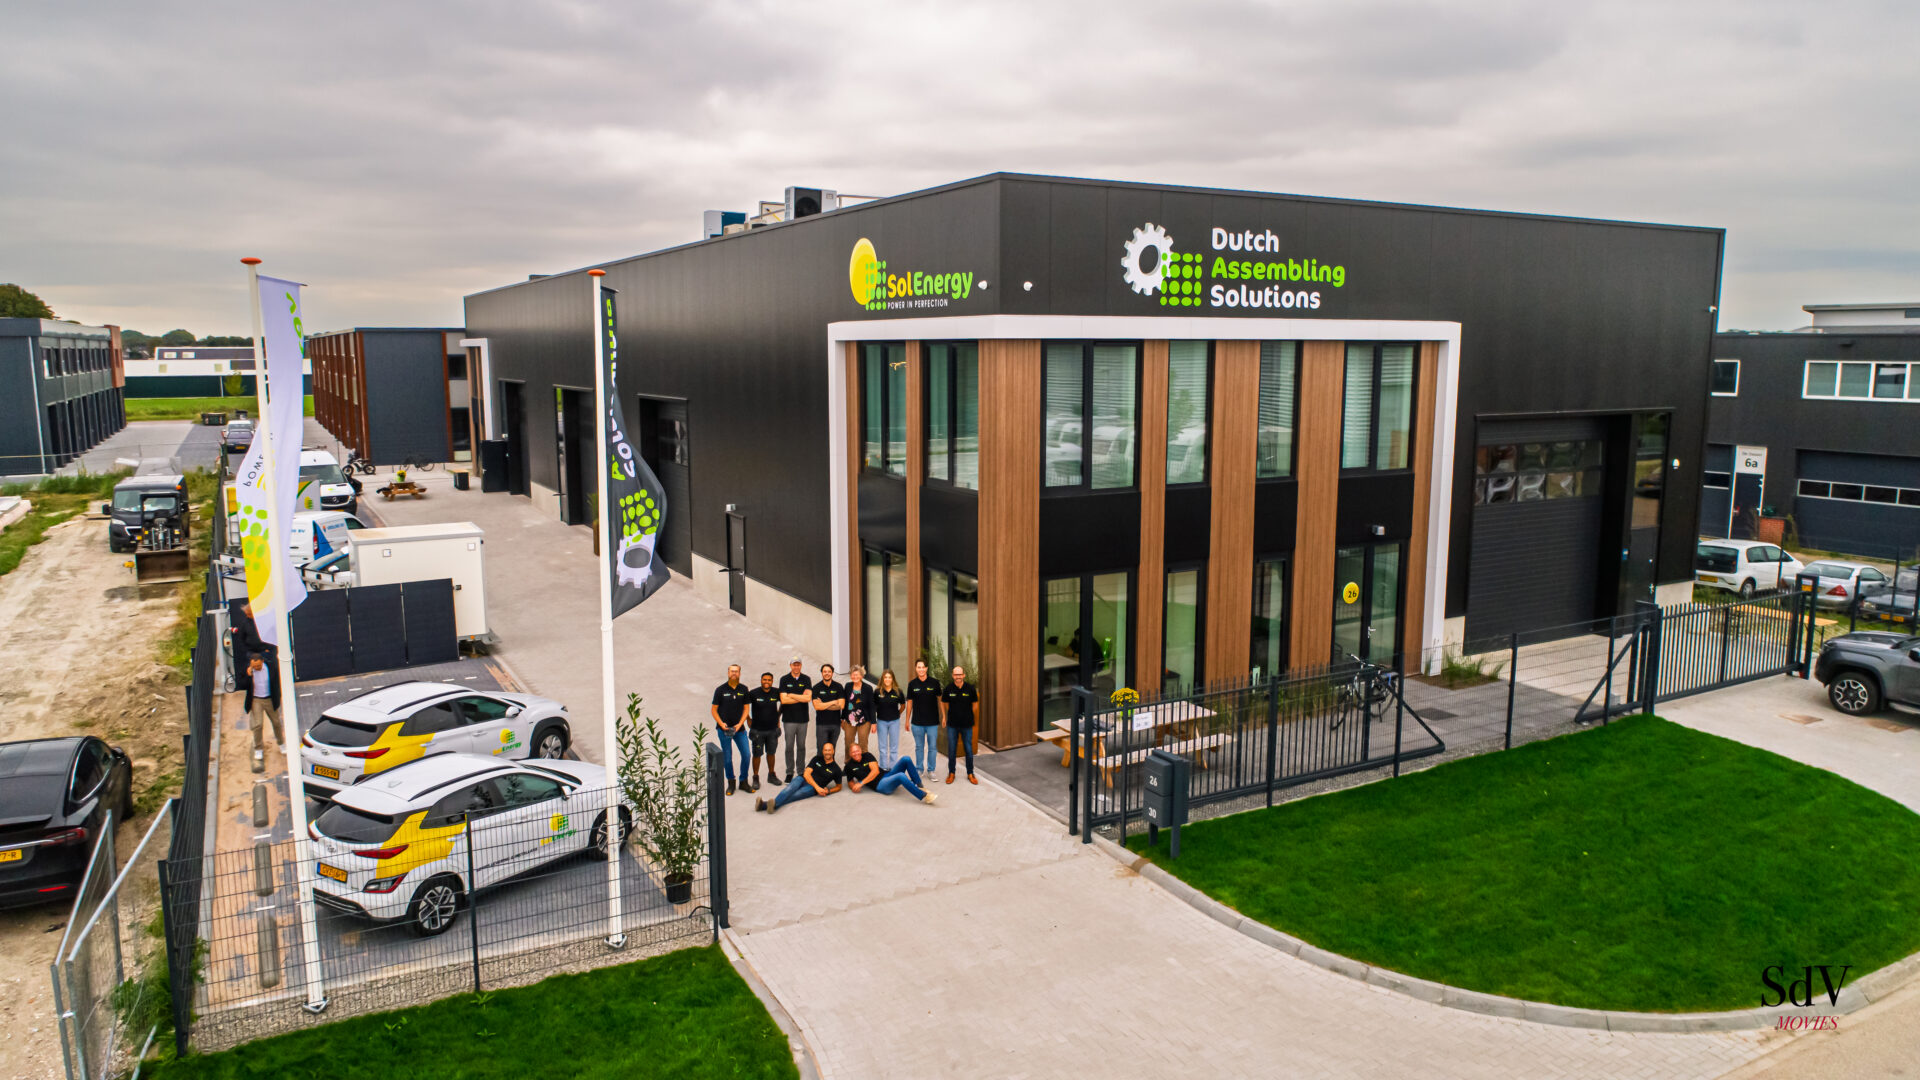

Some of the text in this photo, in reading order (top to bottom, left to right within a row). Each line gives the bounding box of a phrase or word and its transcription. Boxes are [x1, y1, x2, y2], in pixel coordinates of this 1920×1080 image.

[1211, 227, 1280, 253] Dutch
[1211, 256, 1346, 288] Assembling
[887, 271, 974, 300] SolEnergy
[1210, 284, 1321, 309] Solutions
[887, 299, 949, 310] POWER IN PERFECTION
[1745, 458, 1758, 468] 6a
[1348, 590, 1358, 599] 26
[1149, 775, 1158, 787] 26
[1148, 807, 1157, 819] 30
[0, 852, 17, 860] 7-R
